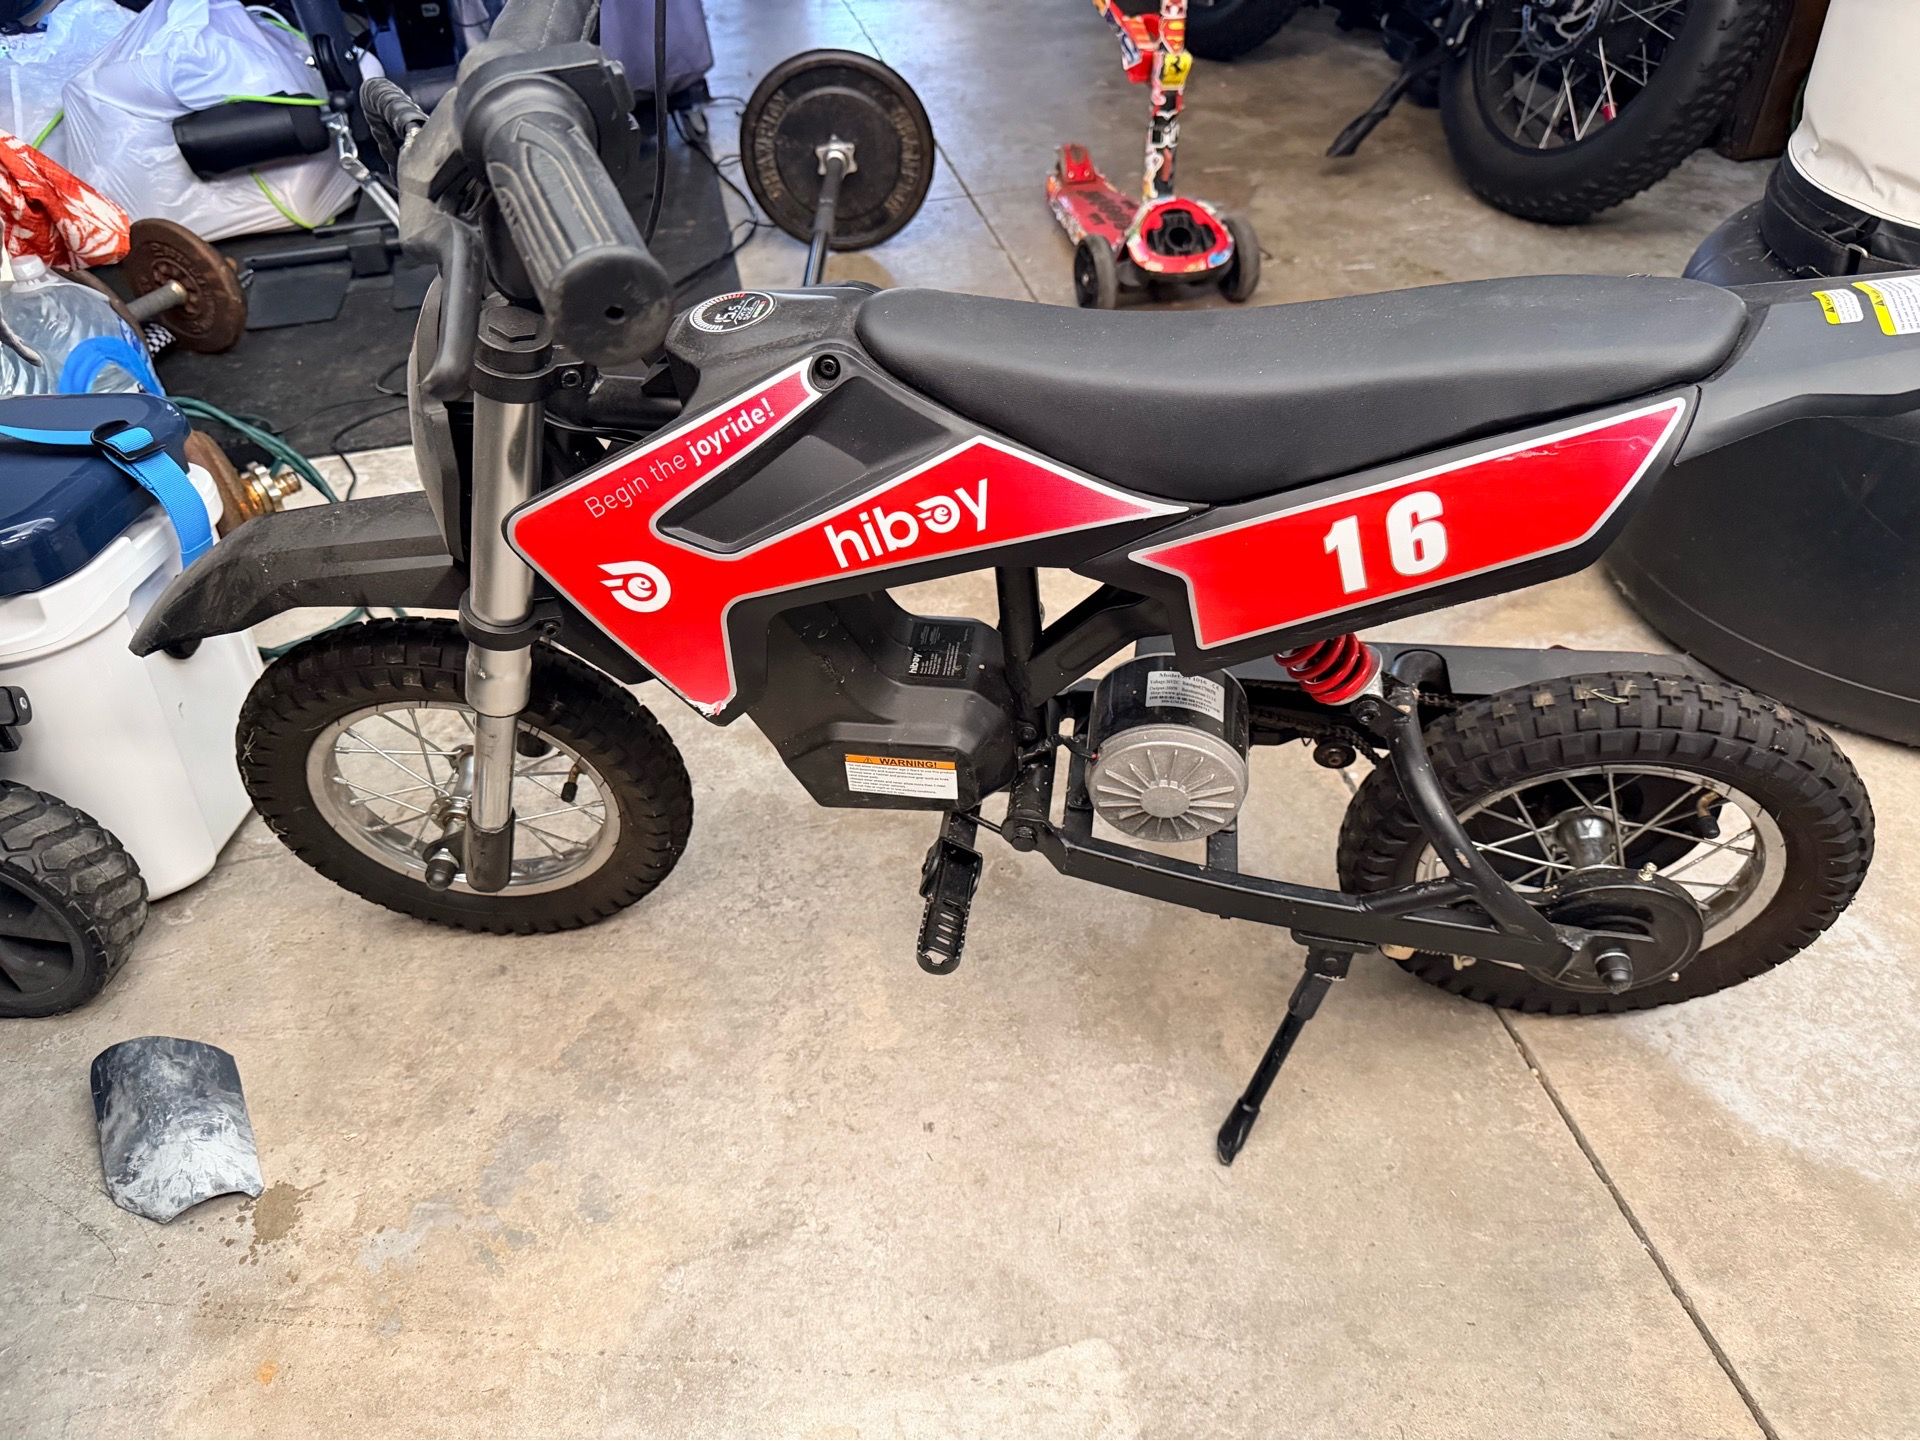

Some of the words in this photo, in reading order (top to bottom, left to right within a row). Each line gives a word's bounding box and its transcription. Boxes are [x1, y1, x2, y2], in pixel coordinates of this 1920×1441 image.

[584, 476, 650, 519] Begin
[650, 454, 687, 482] the
[686, 397, 775, 466] joyride!
[823, 477, 989, 569] hiboy
[908, 652, 923, 674] hiboy
[879, 757, 938, 769] WARNING!
